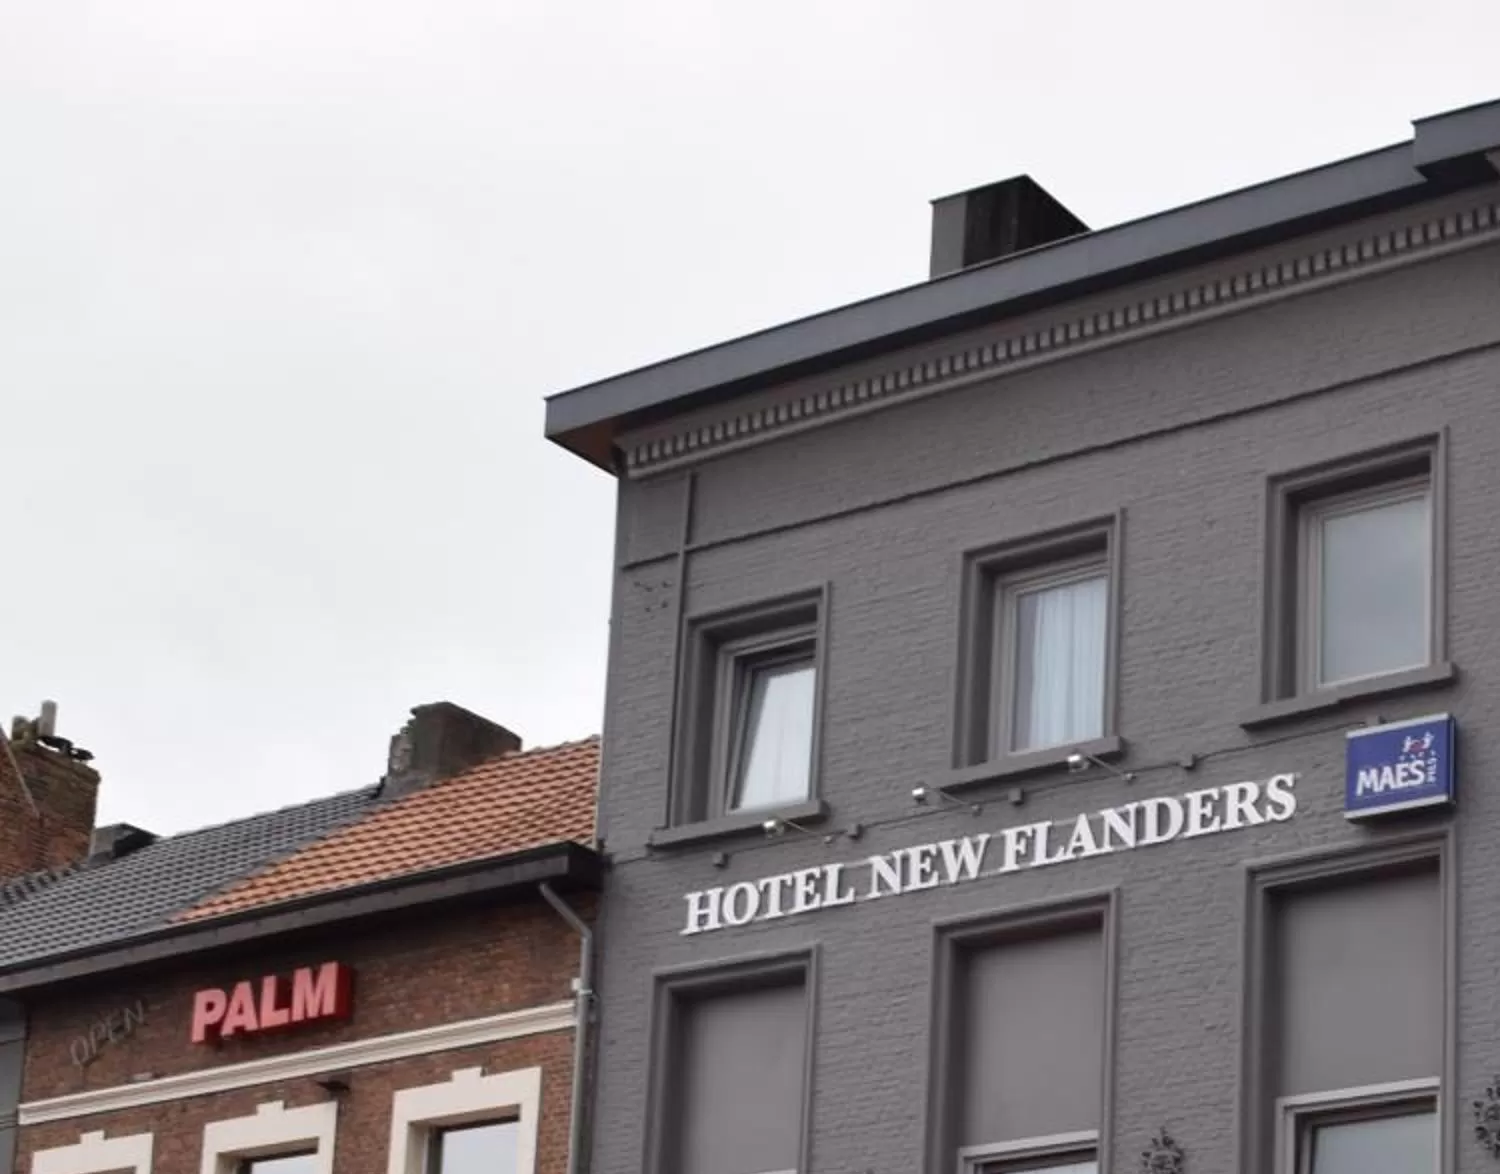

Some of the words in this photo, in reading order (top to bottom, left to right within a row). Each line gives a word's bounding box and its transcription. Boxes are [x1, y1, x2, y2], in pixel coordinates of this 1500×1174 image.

[1356, 758, 1425, 797] MAES
[679, 862, 855, 936] HOTEL
[866, 832, 991, 901] NEW
[998, 772, 1298, 873] FLANDERS
[69, 1000, 146, 1066] OPEN
[191, 960, 341, 1044] PALM
